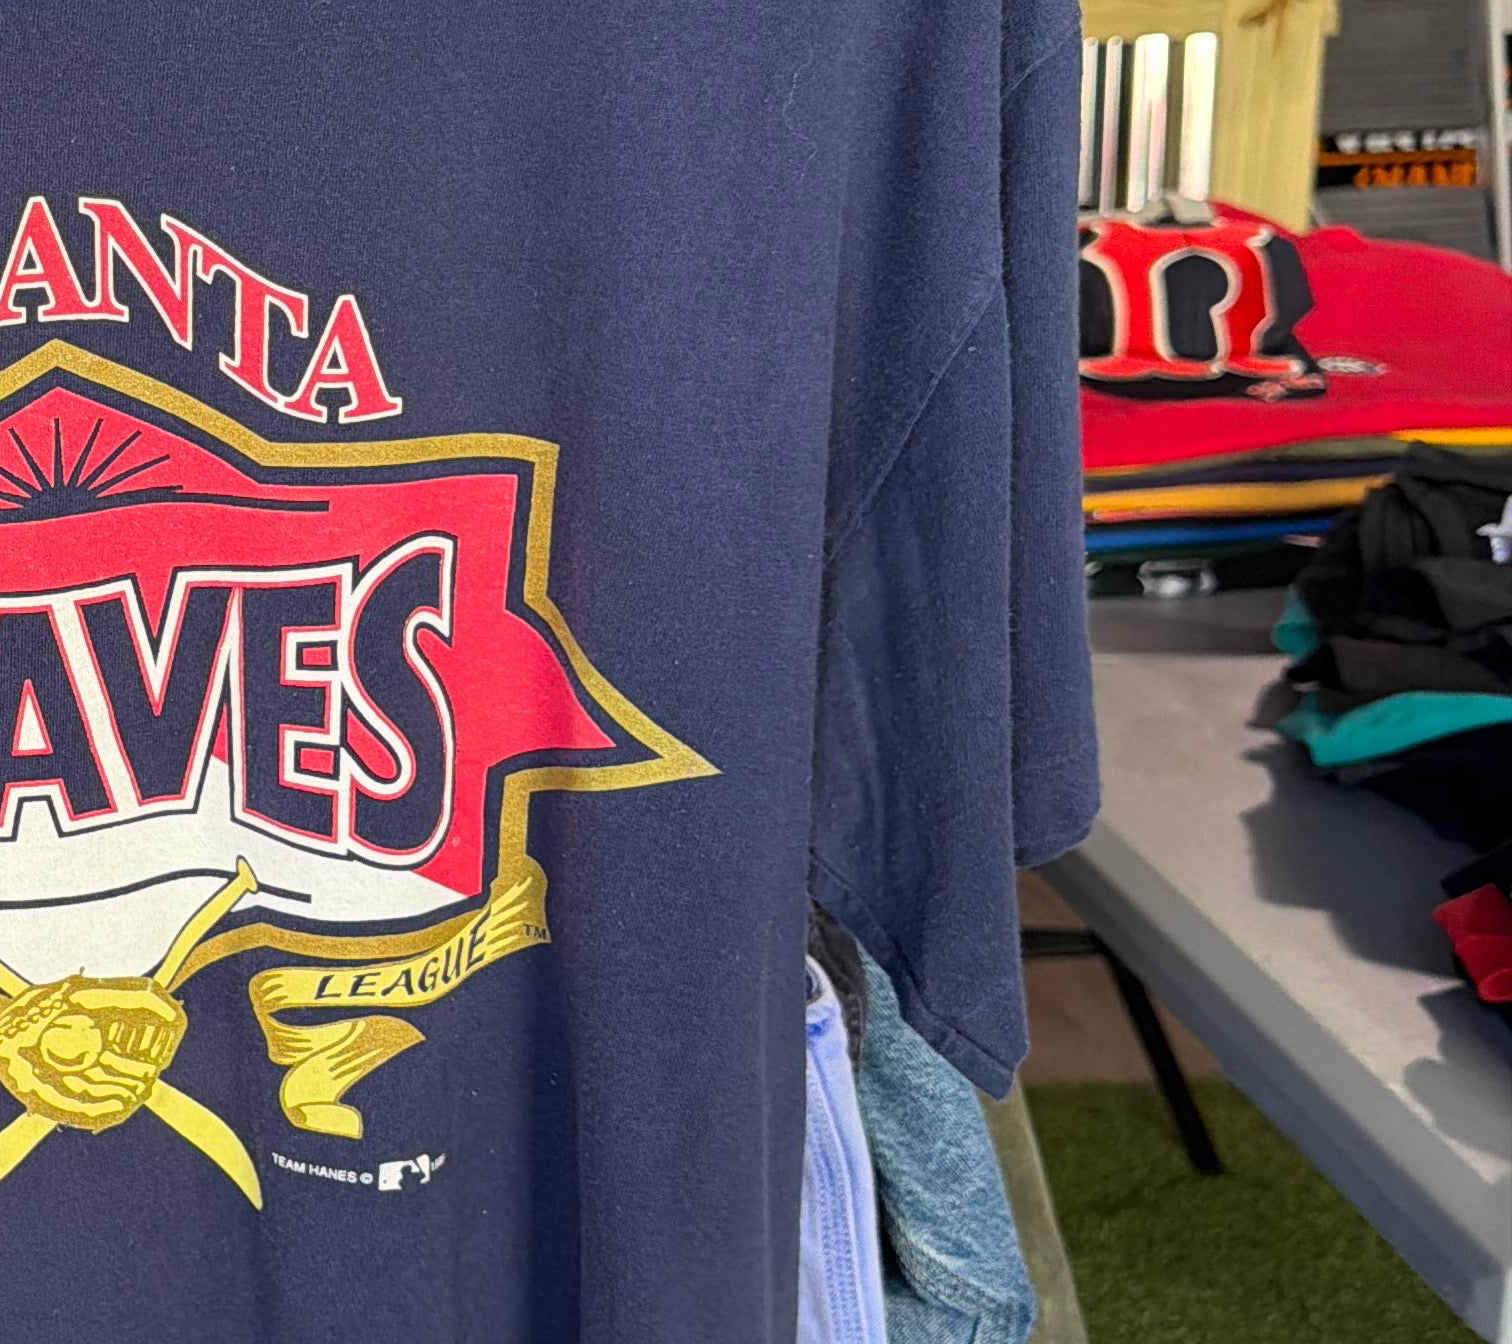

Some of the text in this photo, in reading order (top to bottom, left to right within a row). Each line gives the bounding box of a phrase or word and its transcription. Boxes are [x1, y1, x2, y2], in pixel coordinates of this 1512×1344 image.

[314, 910, 491, 1000] LEAGUE
[272, 1151, 306, 1175] TEAM
[309, 1162, 358, 1184] HANES
